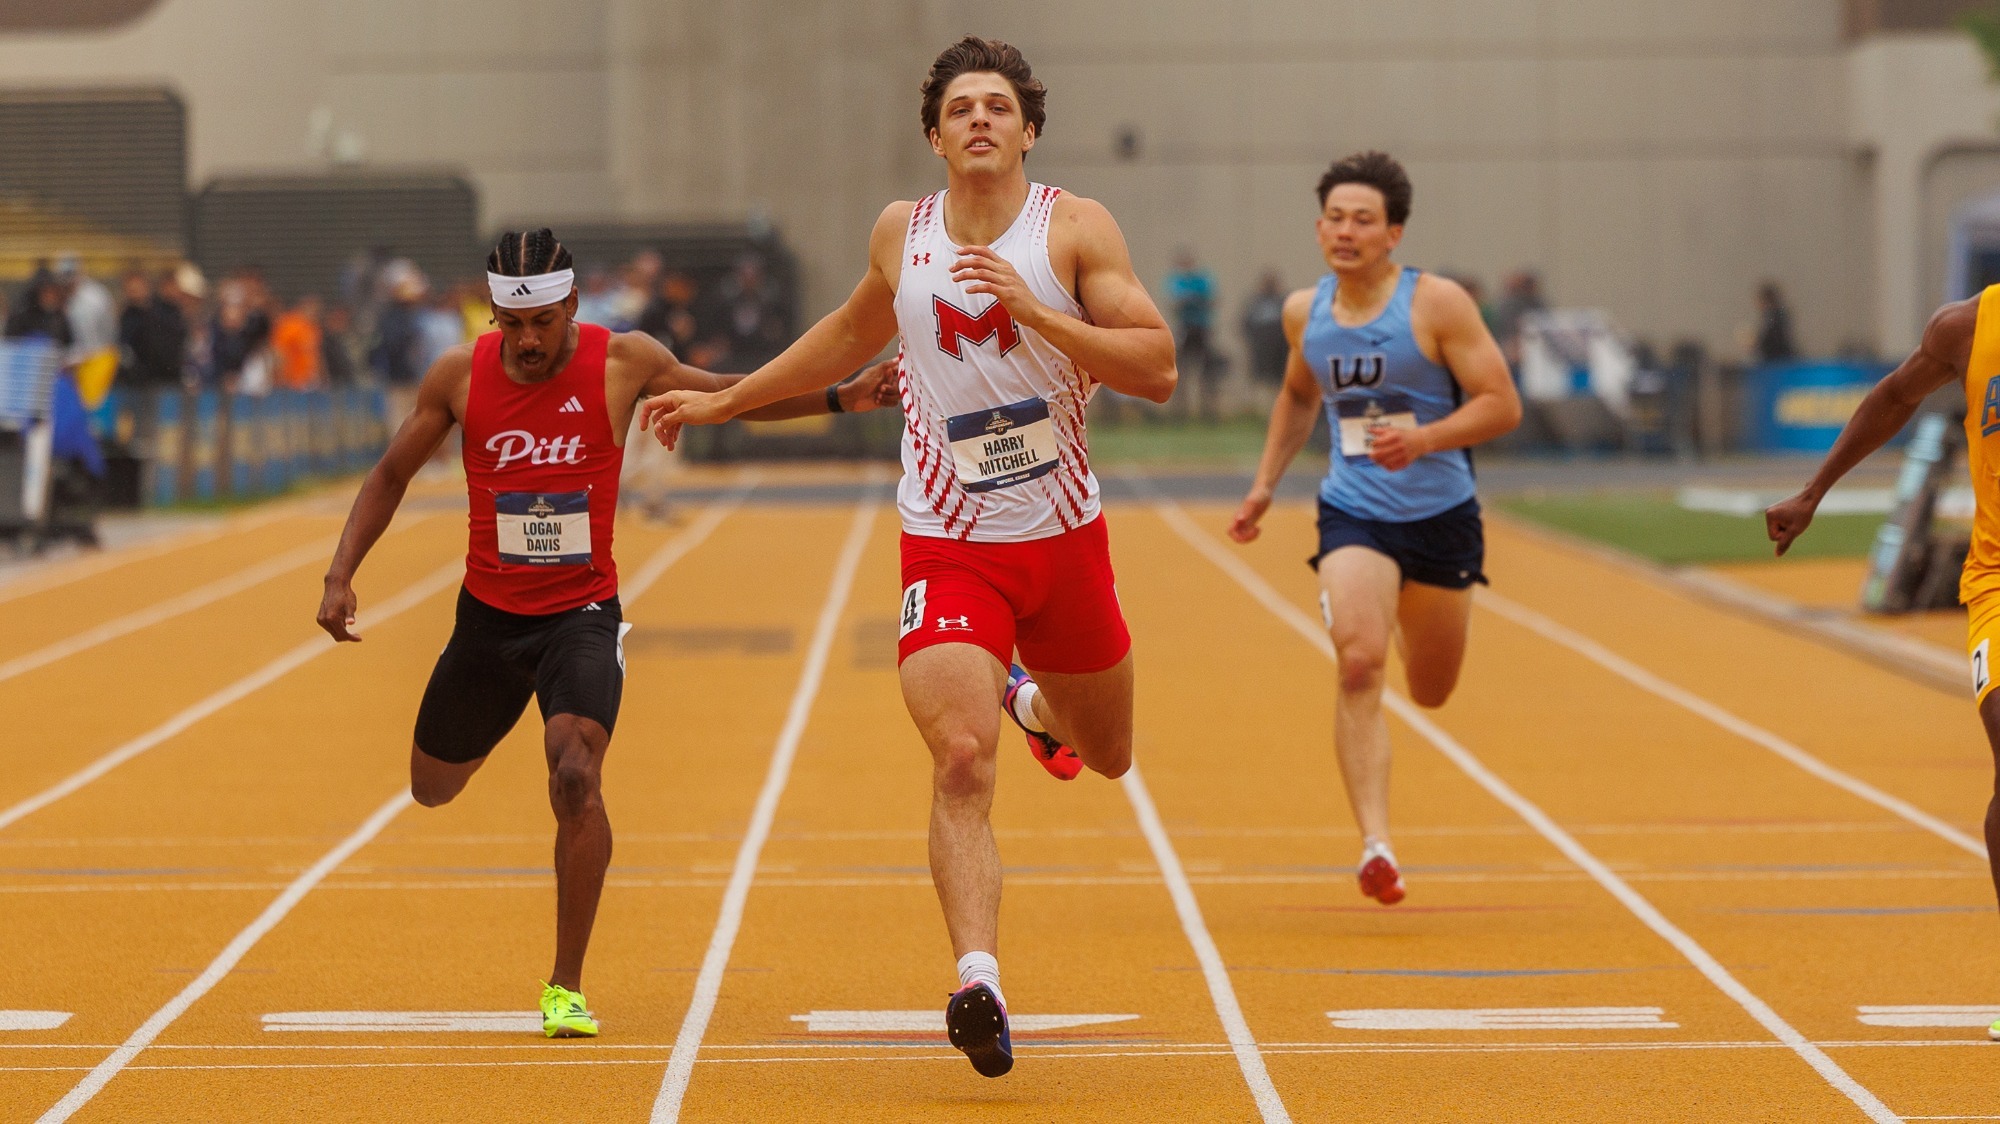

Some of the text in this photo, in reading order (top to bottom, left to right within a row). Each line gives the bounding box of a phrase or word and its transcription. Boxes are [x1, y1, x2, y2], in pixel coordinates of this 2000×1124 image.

[932, 294, 1021, 363] M
[485, 430, 587, 472] Pitt
[978, 448, 1040, 476] MITCHELL
[983, 434, 1025, 457] HARRY
[523, 522, 562, 536] LOGAN
[527, 538, 561, 552] DAVIS
[903, 587, 918, 630] 4
[1973, 650, 1984, 694] 2
